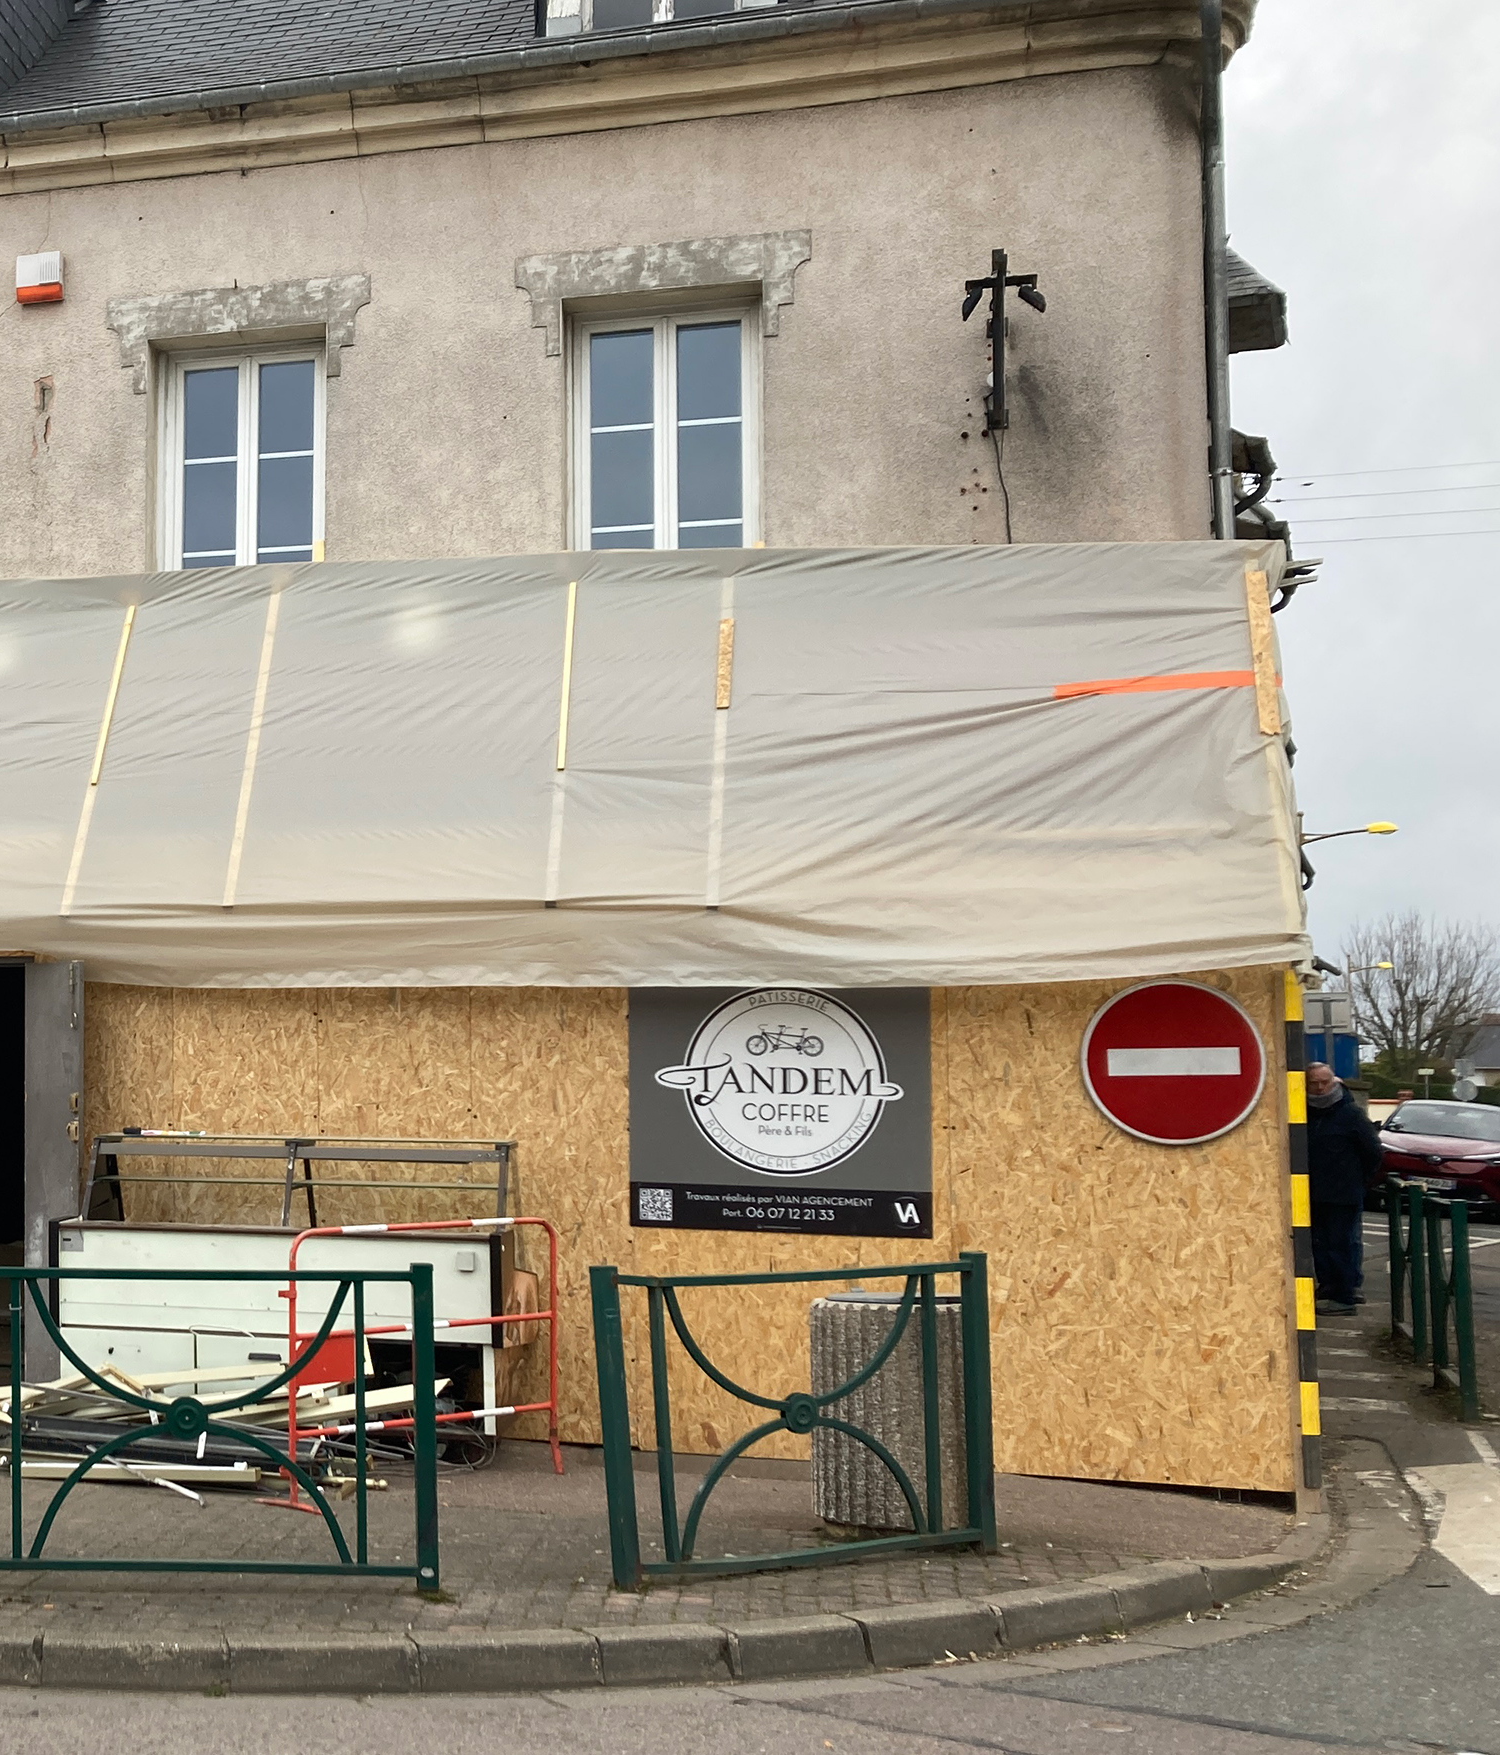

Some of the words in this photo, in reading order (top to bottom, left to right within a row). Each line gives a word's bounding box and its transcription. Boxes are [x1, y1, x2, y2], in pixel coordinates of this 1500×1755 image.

[747, 991, 830, 1013] PATISSERIE
[658, 1053, 900, 1107] TANDEM
[741, 1102, 830, 1123] COFFRE
[704, 1118, 798, 1169] BOULANGERIE
[813, 1111, 873, 1166] SNACKING
[757, 1124, 783, 1137] Père
[784, 1125, 793, 1137] &
[794, 1125, 813, 1138] Fils
[685, 1191, 721, 1202] Travaux
[721, 1193, 756, 1203] réalisés
[757, 1196, 774, 1205] par
[775, 1195, 801, 1204] VIAN
[802, 1196, 875, 1207] AGENCEMENT
[745, 1206, 765, 1218] 06
[767, 1207, 786, 1219] 07
[788, 1208, 801, 1220] 12
[803, 1209, 816, 1220] 21
[818, 1209, 836, 1221] 33
